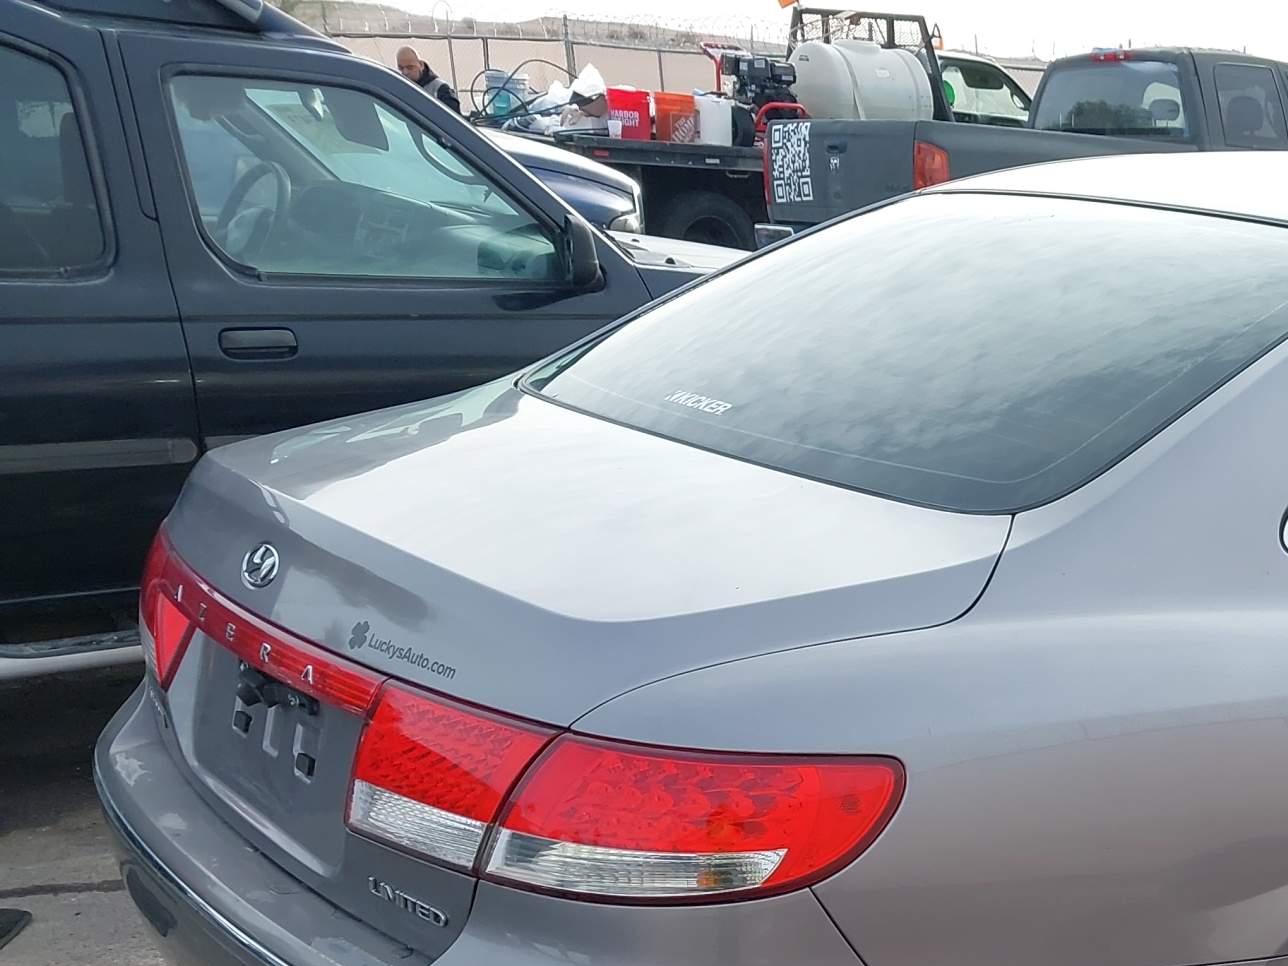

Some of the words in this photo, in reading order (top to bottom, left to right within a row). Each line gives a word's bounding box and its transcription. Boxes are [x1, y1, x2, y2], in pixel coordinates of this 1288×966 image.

[610, 109, 639, 120] HARBOR
[667, 390, 733, 415] KICKER
[174, 584, 314, 685] AZERA
[367, 633, 456, 680] LuckysAuto.com
[368, 876, 446, 927] LIMITED
